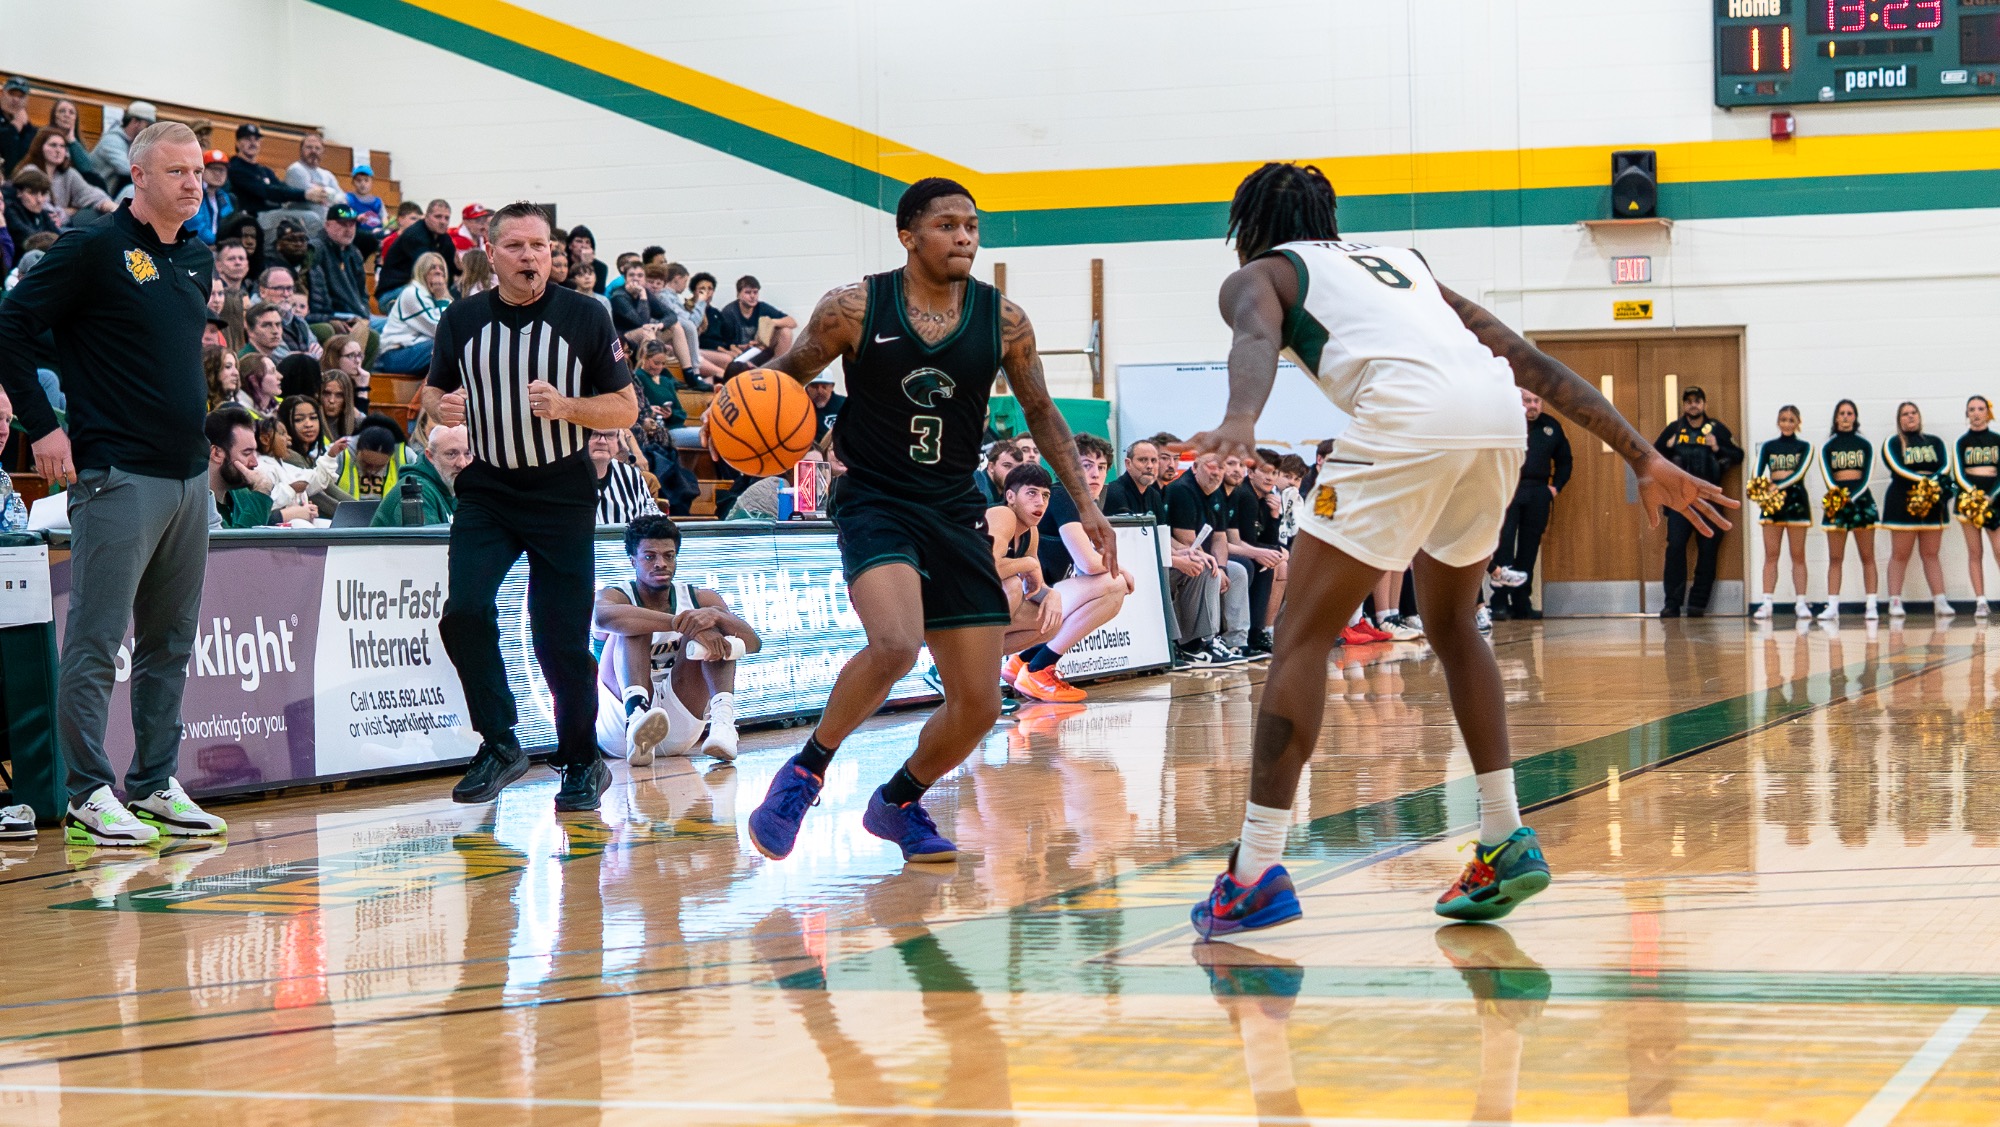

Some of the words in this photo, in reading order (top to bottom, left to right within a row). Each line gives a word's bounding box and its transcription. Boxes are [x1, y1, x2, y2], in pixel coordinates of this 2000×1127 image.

[1728, 0, 1781, 18] Home
[1751, 26, 1791, 72] 11
[1845, 64, 1907, 92] period
[1346, 254, 1417, 291] 8
[1616, 258, 1645, 281] EXIT
[909, 415, 942, 464] 3
[336, 579, 442, 621] Ultra-Fast
[348, 628, 432, 669] Internet
[1101, 626, 1131, 649] Dealers
[350, 691, 370, 712] Call
[369, 686, 445, 710] 1.855.692.4116
[188, 714, 242, 742] working
[241, 711, 262, 736] for
[264, 714, 288, 739] you.
[349, 722, 361, 738] or
[361, 716, 386, 737] visit
[382, 711, 462, 739] Sparklight.com
